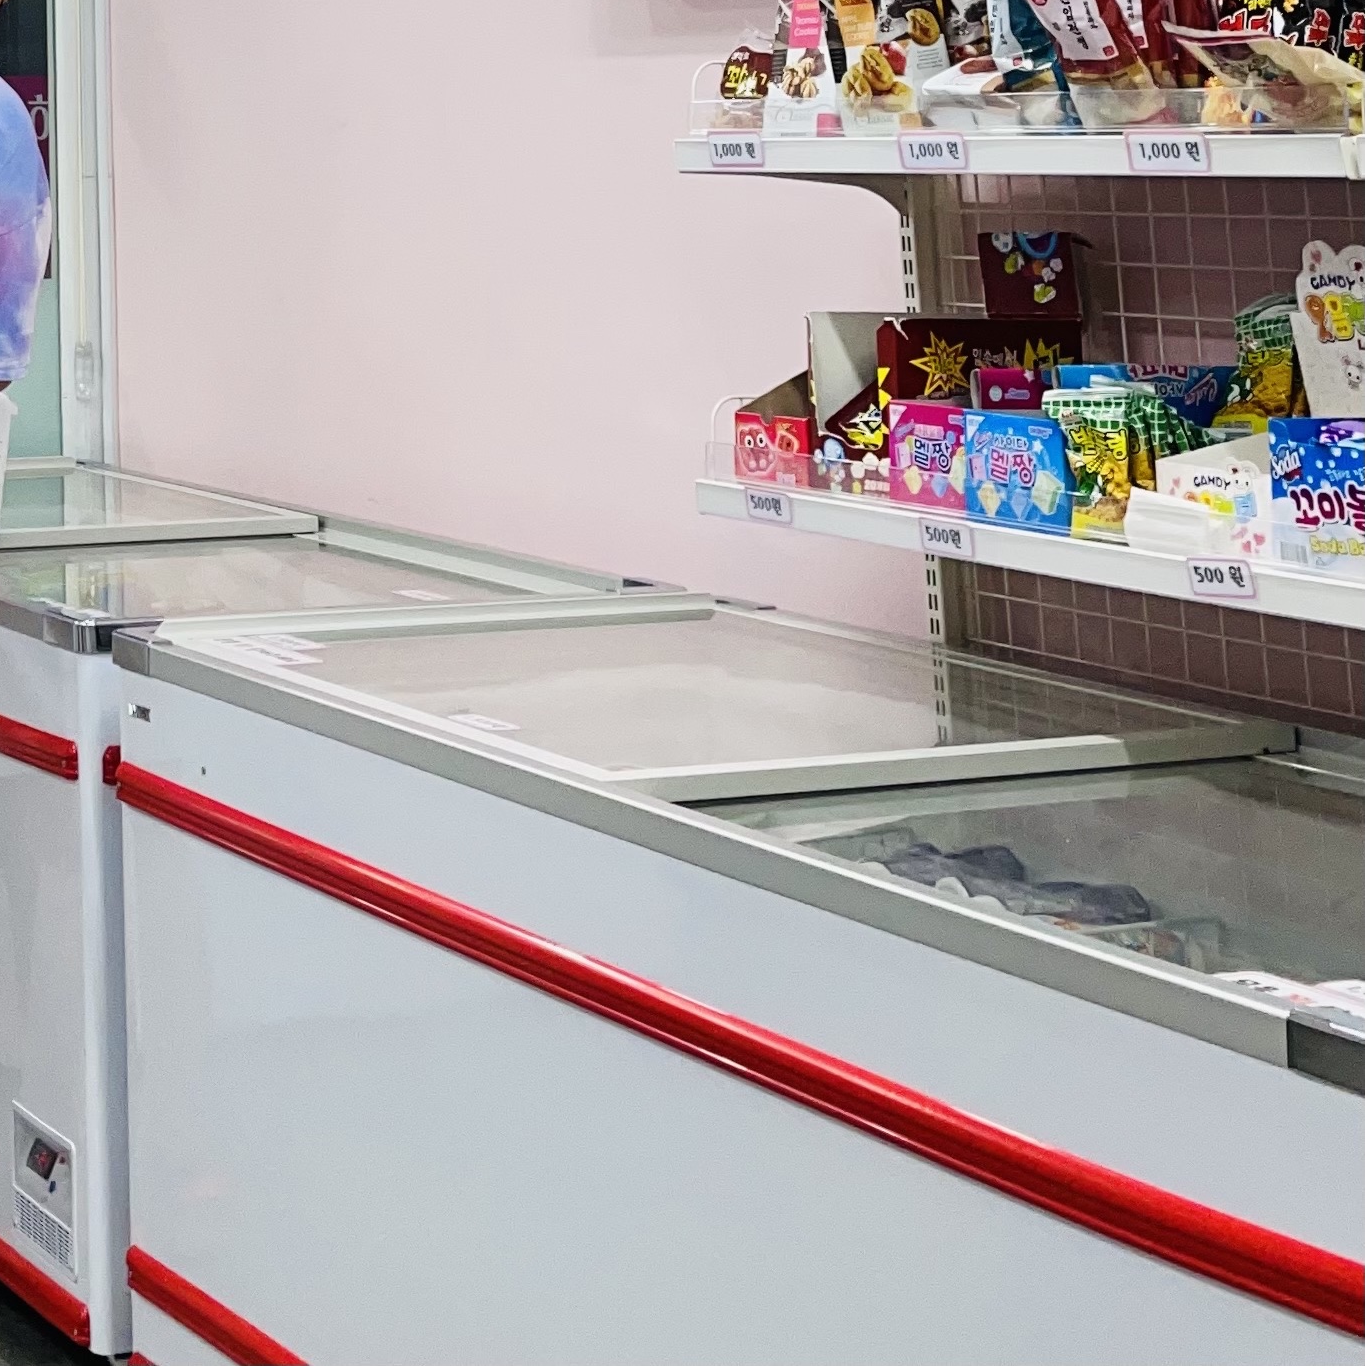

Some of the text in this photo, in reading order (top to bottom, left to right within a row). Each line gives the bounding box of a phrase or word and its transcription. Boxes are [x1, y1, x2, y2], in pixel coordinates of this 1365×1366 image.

[713, 141, 757, 159] 1,000 원
[909, 141, 960, 160] 1,000 원
[1138, 141, 1201, 162] 1,000 원
[913, 436, 952, 474] 멜짱
[994, 436, 1029, 452] 사이다
[989, 447, 1036, 488] 멜짱
[1271, 449, 1302, 480] Soda
[925, 526, 962, 550] 500원
[1193, 565, 1246, 589] 500 원
